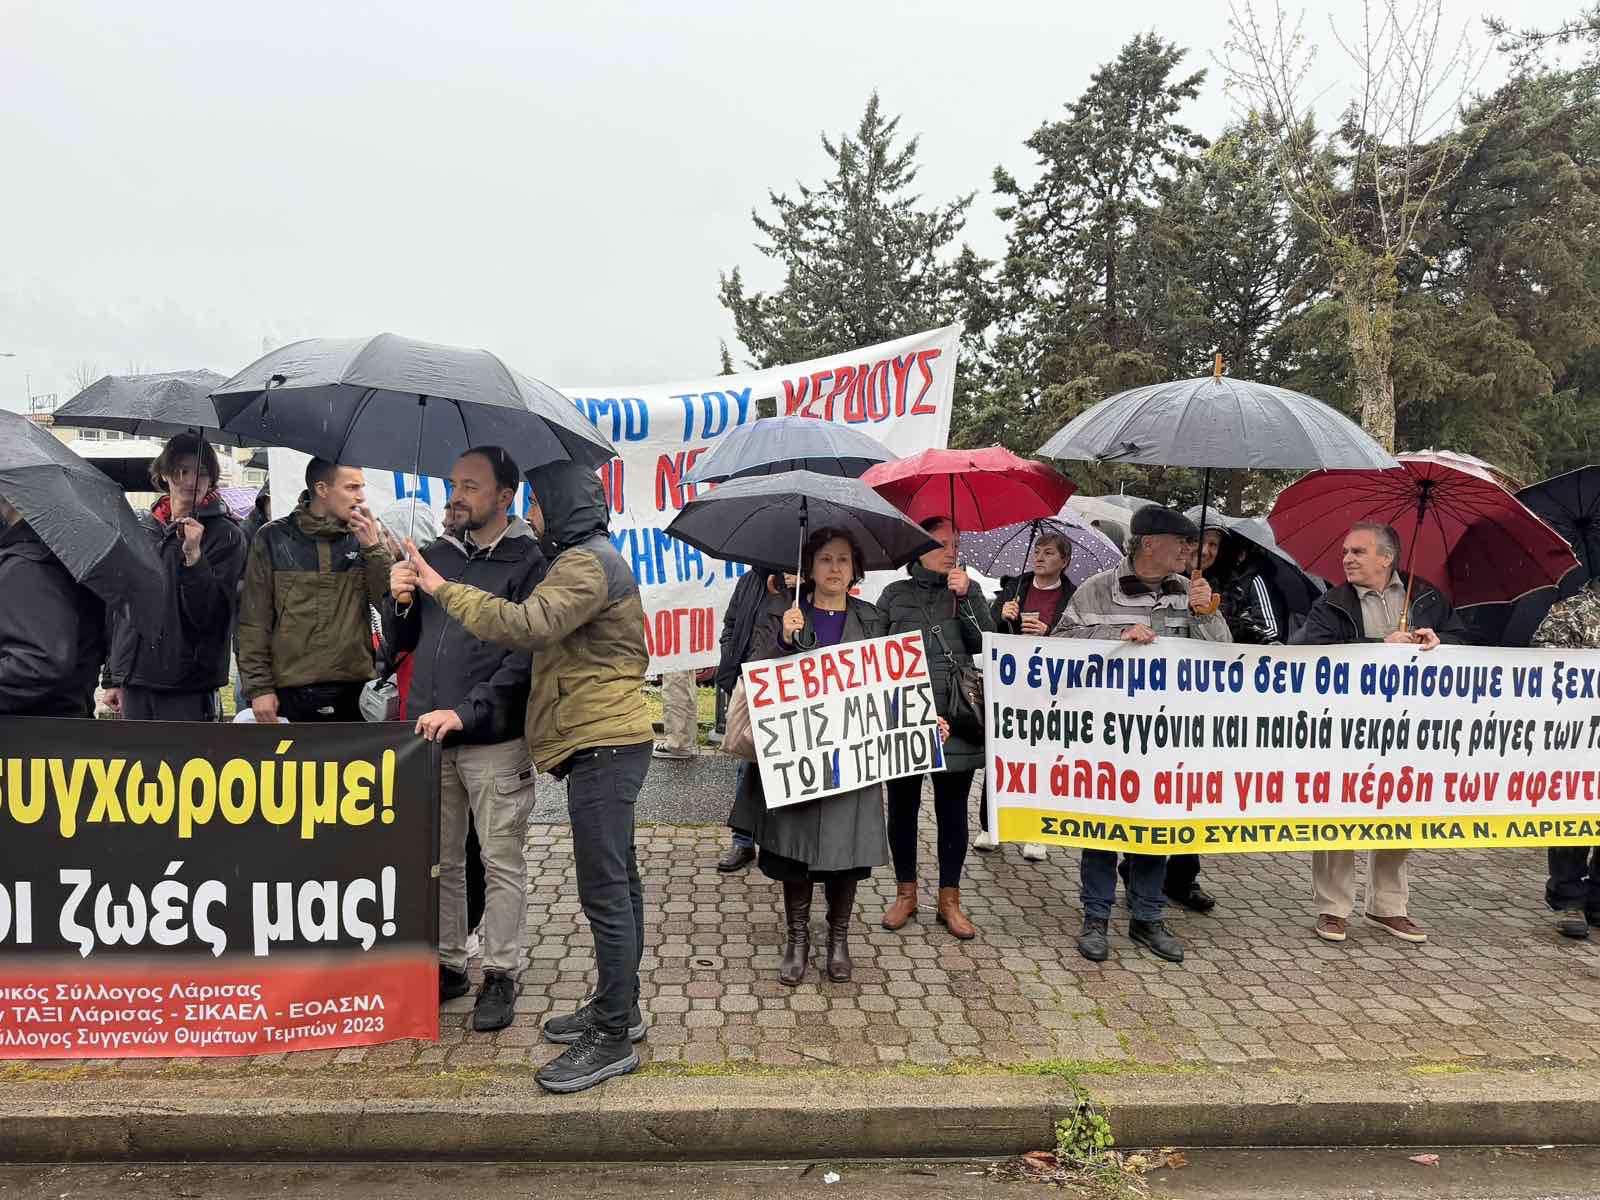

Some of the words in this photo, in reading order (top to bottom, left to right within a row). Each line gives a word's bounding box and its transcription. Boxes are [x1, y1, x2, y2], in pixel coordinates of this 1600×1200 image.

[669, 387, 752, 442] ΤΟΥ
[749, 635, 926, 708] ΣΕΒΑΣΜΟΣ
[1027, 646, 1167, 697] έγκλημα
[1177, 653, 1246, 694] αυτό
[1254, 655, 1306, 694] δεν
[1315, 656, 1349, 695] θα
[1360, 655, 1503, 703] αφήσουμε
[1512, 665, 1543, 698] να
[1552, 661, 1600, 705] ξεχ
[758, 702, 834, 758] ΣΤΙΣ
[843, 682, 937, 740] ΜΑΝΕΣ
[1103, 705, 1205, 755] εγγόνια
[1213, 715, 1248, 748] και
[1256, 708, 1332, 750] παιδιά
[1341, 708, 1410, 756] νεκρά
[1417, 718, 1462, 757] στις
[1469, 710, 1536, 757] ράγες
[1544, 719, 1584, 750] των
[0, 740, 396, 839] υγχωρούμε!
[1050, 754, 1141, 804] άλλο
[1154, 762, 1223, 811] αίμα
[1235, 770, 1284, 811] για
[1295, 771, 1331, 804] τα
[1341, 763, 1433, 810] κέρδη
[1444, 771, 1500, 802] των
[1041, 816, 1195, 845] ΣΩΜΑΤΕΙΟ
[1204, 822, 1412, 843] ΣΥΝΤΑΞΙΟΥΧΩΝ
[1421, 822, 1465, 840] ΙΚΑ
[1473, 821, 1496, 838] Ν.
[59, 861, 227, 958] ζωές
[252, 865, 396, 956] μας!
[12, 1007, 63, 1023] ΤΑΞΙ
[70, 1007, 163, 1025] Λάρισας
[185, 1004, 268, 1021] ΣΙΚΑΕΛ
[289, 994, 385, 1019] ΕΟΑΣΝΛ
[56, 984, 163, 1003] Σύλλογος
[169, 982, 262, 1001] Λάρισας
[77, 1028, 168, 1048] Συγγενών
[175, 1027, 257, 1047] Θυμάτων
[264, 1021, 338, 1043] Τεμπών
[343, 1017, 385, 1034] 2023
